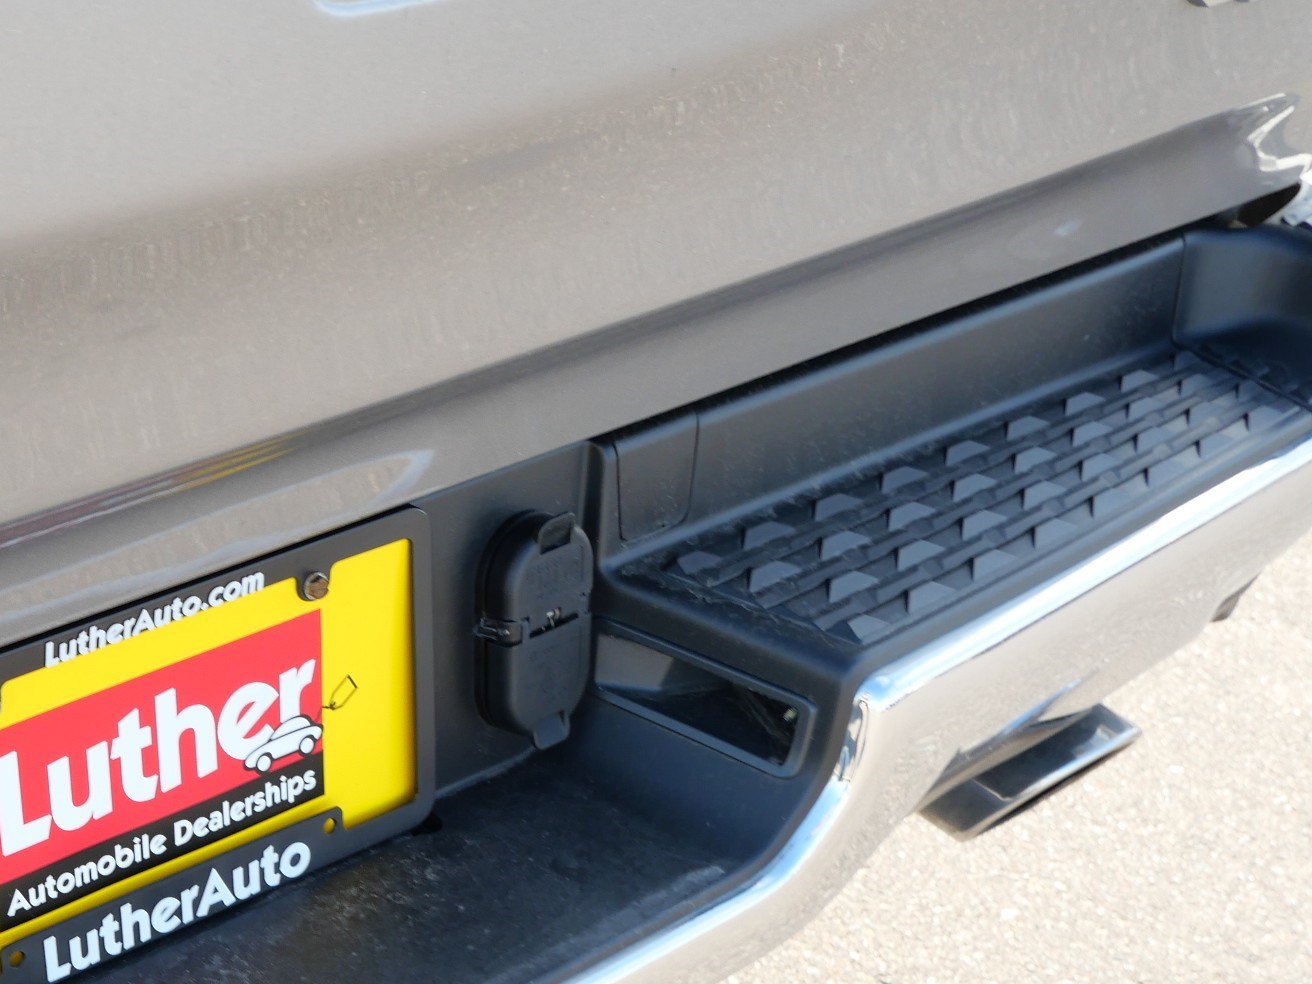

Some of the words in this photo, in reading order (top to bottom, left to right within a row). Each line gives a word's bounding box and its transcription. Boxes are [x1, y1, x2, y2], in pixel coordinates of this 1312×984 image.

[44, 571, 265, 668] LutherAuto.com
[7, 833, 167, 917] Automobile
[173, 769, 317, 847] Dealerships
[43, 841, 312, 983] LutherAuto
